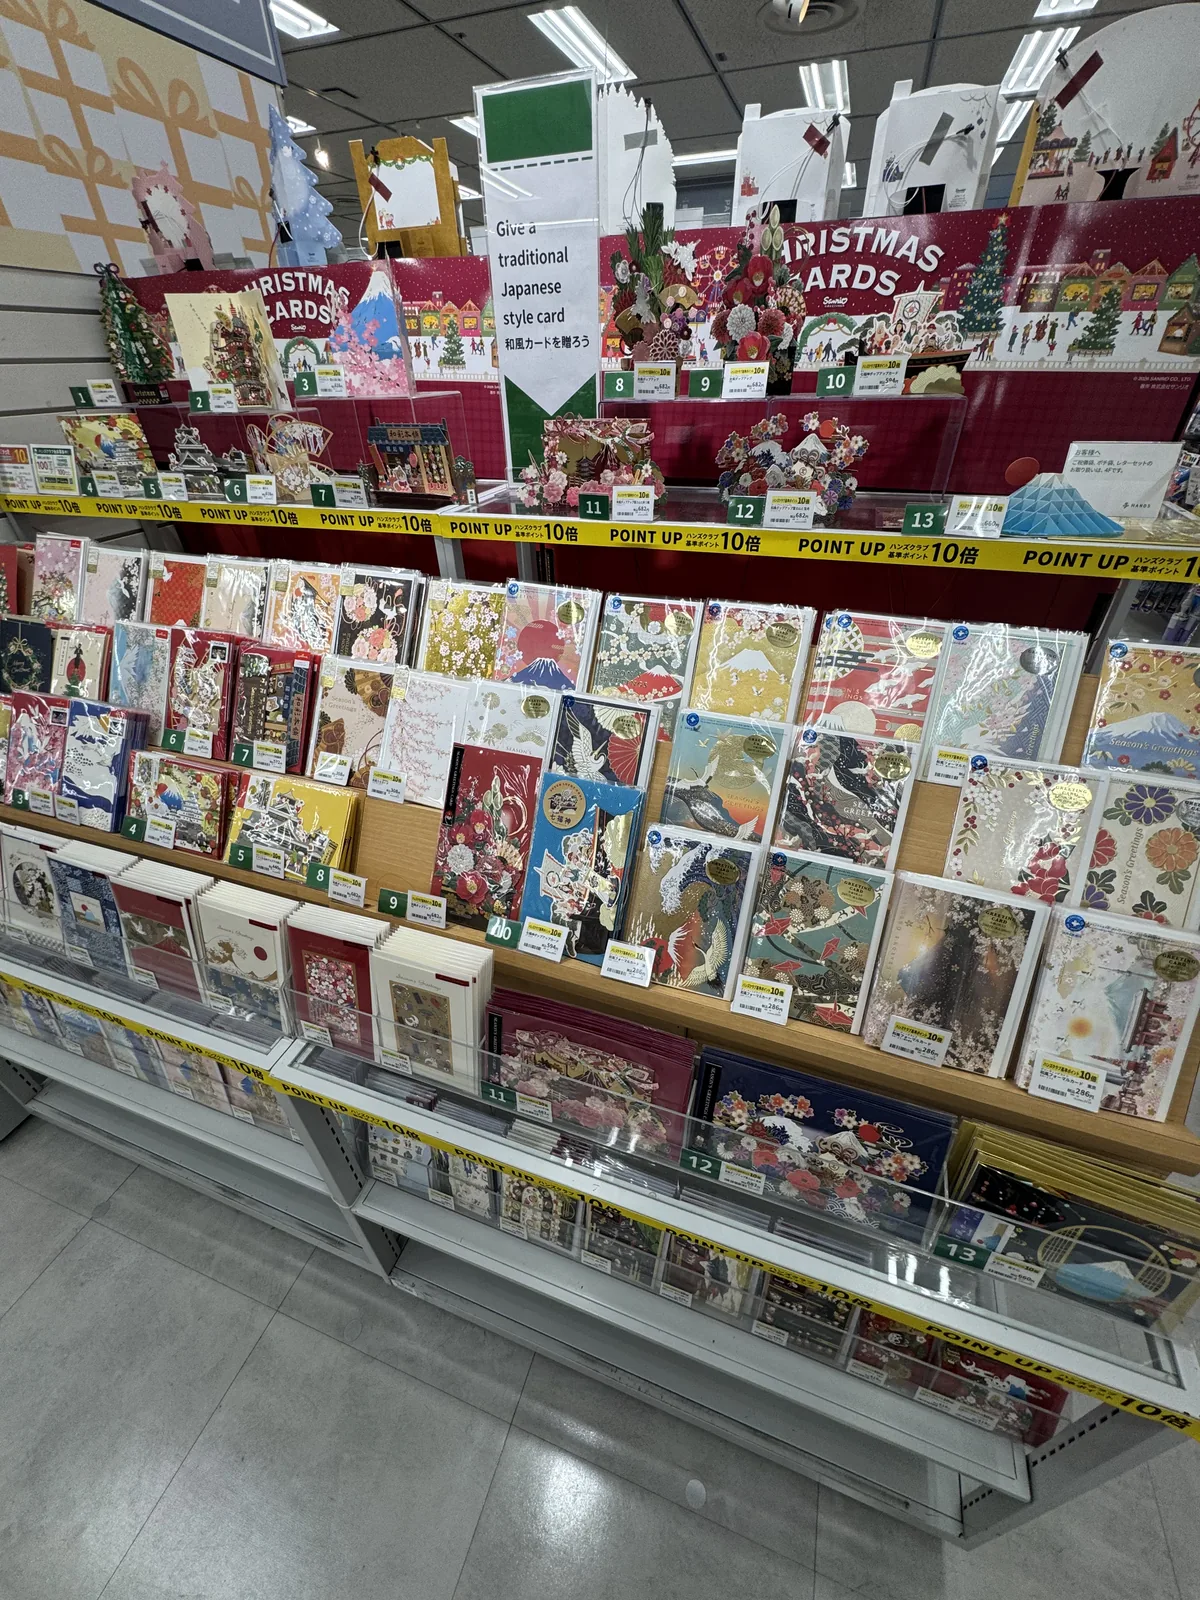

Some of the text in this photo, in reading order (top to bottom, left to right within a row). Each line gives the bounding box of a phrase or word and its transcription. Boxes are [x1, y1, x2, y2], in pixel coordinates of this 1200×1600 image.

[496, 220, 537, 237] Give a
[498, 246, 569, 268] traditional
[781, 227, 945, 272] HRISTMAS
[501, 281, 562, 300] Japanese
[503, 307, 565, 328] style card
[505, 335, 590, 351] 和風カードを贈ろう
[302, 378, 309, 391] 3
[615, 378, 624, 392] 8
[701, 376, 710, 391] 9
[825, 373, 846, 389] 10
[79, 393, 87, 403] 1
[196, 397, 203, 408] 2
[87, 482, 93, 493] 4
[150, 483, 156, 495] 5
[234, 484, 242, 496] 6
[319, 489, 326, 501] 7
[4, 499, 30, 509] POINT
[30, 499, 41, 510] UP
[96, 503, 123, 514] POINT
[126, 505, 138, 515] UP
[157, 504, 183, 519] 10倍
[586, 501, 602, 515] 11
[734, 503, 754, 519] 12
[200, 508, 231, 520] POINT
[235, 509, 248, 521] UP
[270, 509, 299, 525] 10倍
[320, 513, 355, 526] POINT
[359, 515, 375, 527] UP
[401, 515, 432, 533] 10倍
[911, 512, 934, 528] 13
[450, 521, 489, 534] POINT
[494, 523, 512, 535] UP
[544, 524, 579, 542] 10倍
[610, 529, 656, 544] POINT
[662, 531, 682, 545] UP
[721, 531, 761, 552] 10倍
[685, 540, 720, 548] 基準ポイント
[798, 538, 979, 565] POINT UP ハンズクラブ 10倍
[887, 551, 928, 560] 基準ポイント
[1023, 550, 1092, 568] POINT
[1097, 554, 1129, 570] UP
[1133, 556, 1183, 565] ハンズクラブ
[1130, 565, 1179, 575] 基準ポイント
[169, 734, 176, 745] 6
[1109, 737, 1199, 757] Season's Greetings
[241, 748, 250, 762] 7
[18, 794, 23, 804] 3
[550, 814, 571, 825] 七福神
[129, 823, 137, 835] 4
[237, 850, 245, 862] 5
[1117, 826, 1144, 904] Season's Greetings
[316, 869, 325, 882] 8
[844, 880, 872, 892] GREETING
[850, 886, 864, 894] CARD
[389, 896, 398, 909] 9
[991, 917, 1008, 925] CARD
[146, 1029, 183, 1047] POINT
[186, 1043, 202, 1054] UP
[281, 1083, 325, 1104] POINT
[329, 1101, 348, 1112] UP
[489, 1088, 506, 1103] 11
[689, 1155, 713, 1174] 12
[947, 1243, 977, 1262] 13
[926, 1325, 1010, 1357] POINT
[1015, 1357, 1052, 1374] UP
[1118, 1395, 1193, 1430] 10倍
